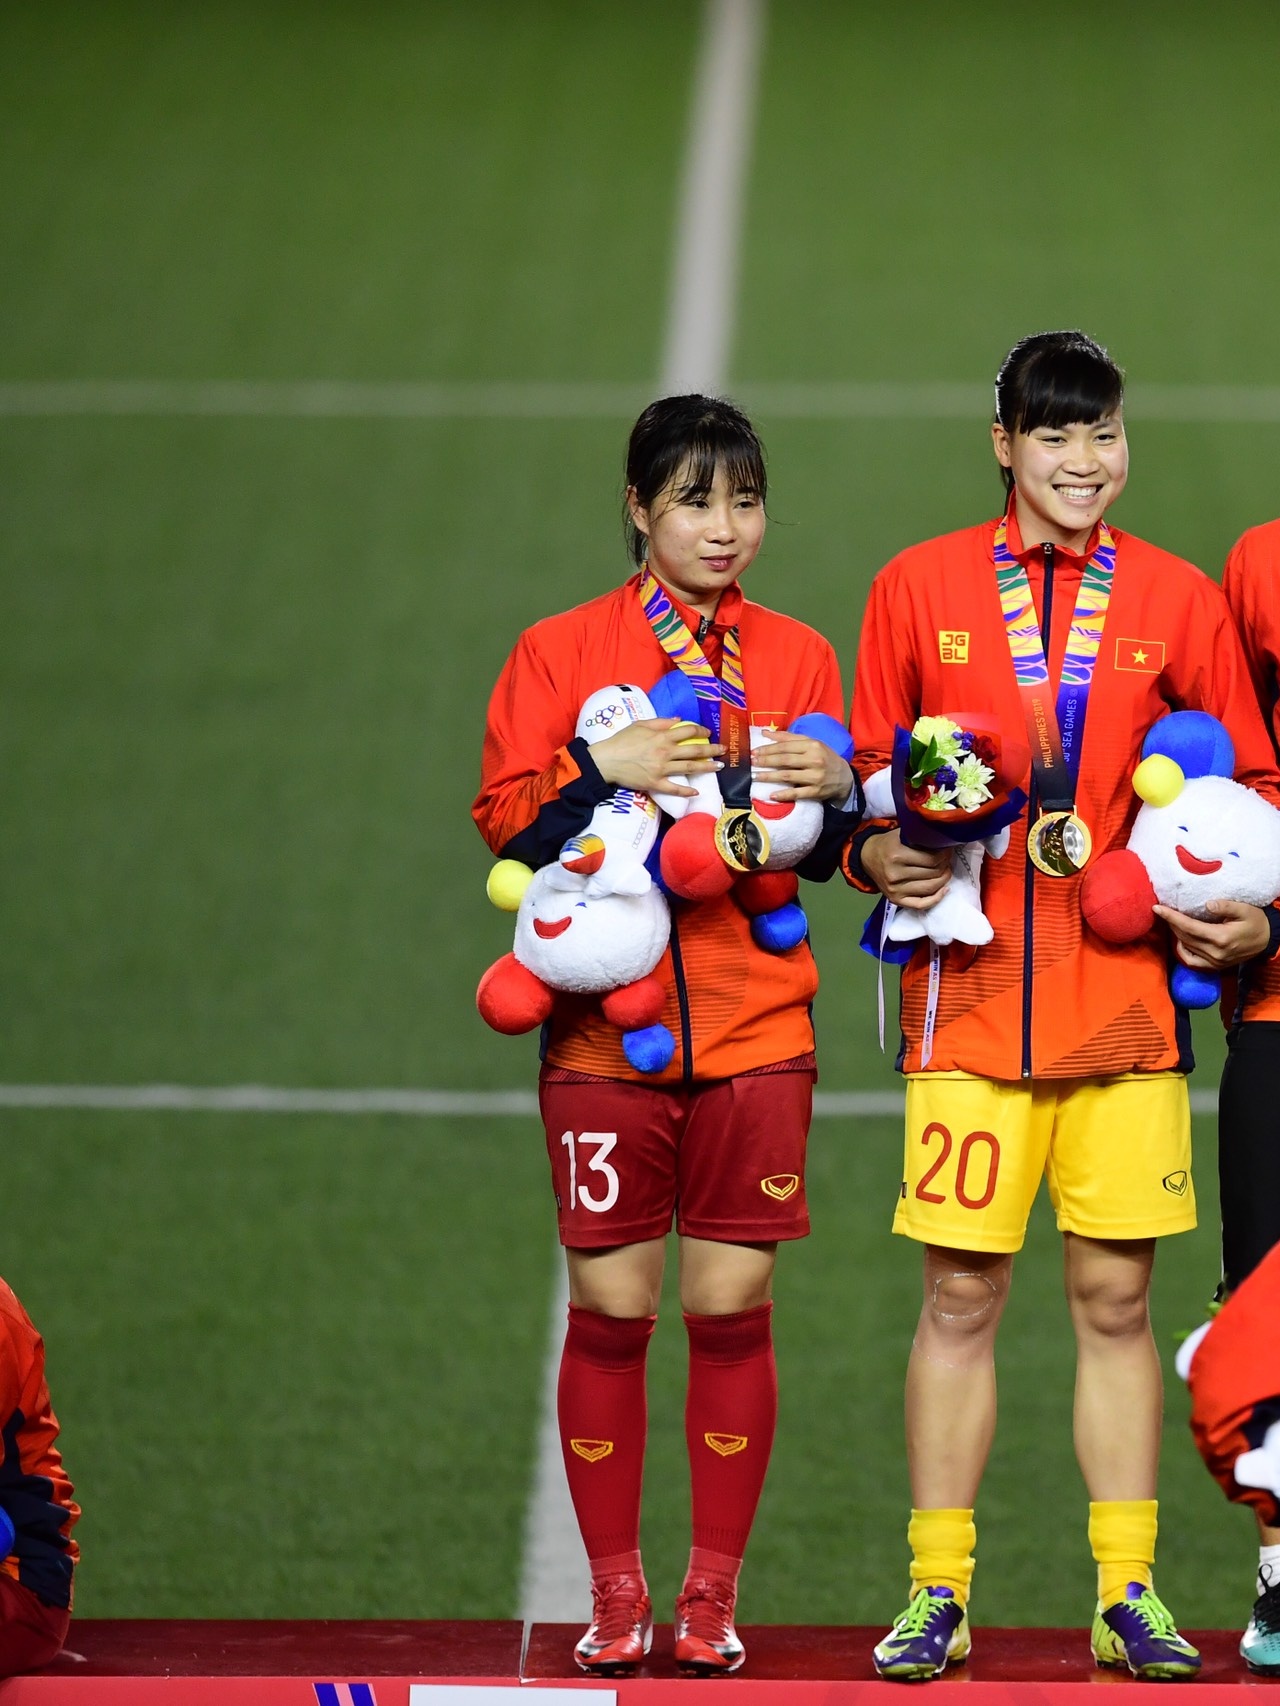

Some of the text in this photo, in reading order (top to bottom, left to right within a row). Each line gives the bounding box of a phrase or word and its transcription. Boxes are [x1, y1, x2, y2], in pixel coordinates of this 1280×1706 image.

[1064, 699, 1077, 729] GAMES
[730, 727, 740, 768] PHILIPPINES
[1031, 698, 1054, 769] PHILIPPINES 2019
[1061, 731, 1073, 748] SEA
[611, 787, 635, 814] WIN
[633, 790, 648, 812] AS
[561, 1130, 620, 1213] 13
[915, 1121, 1001, 1210] 20
